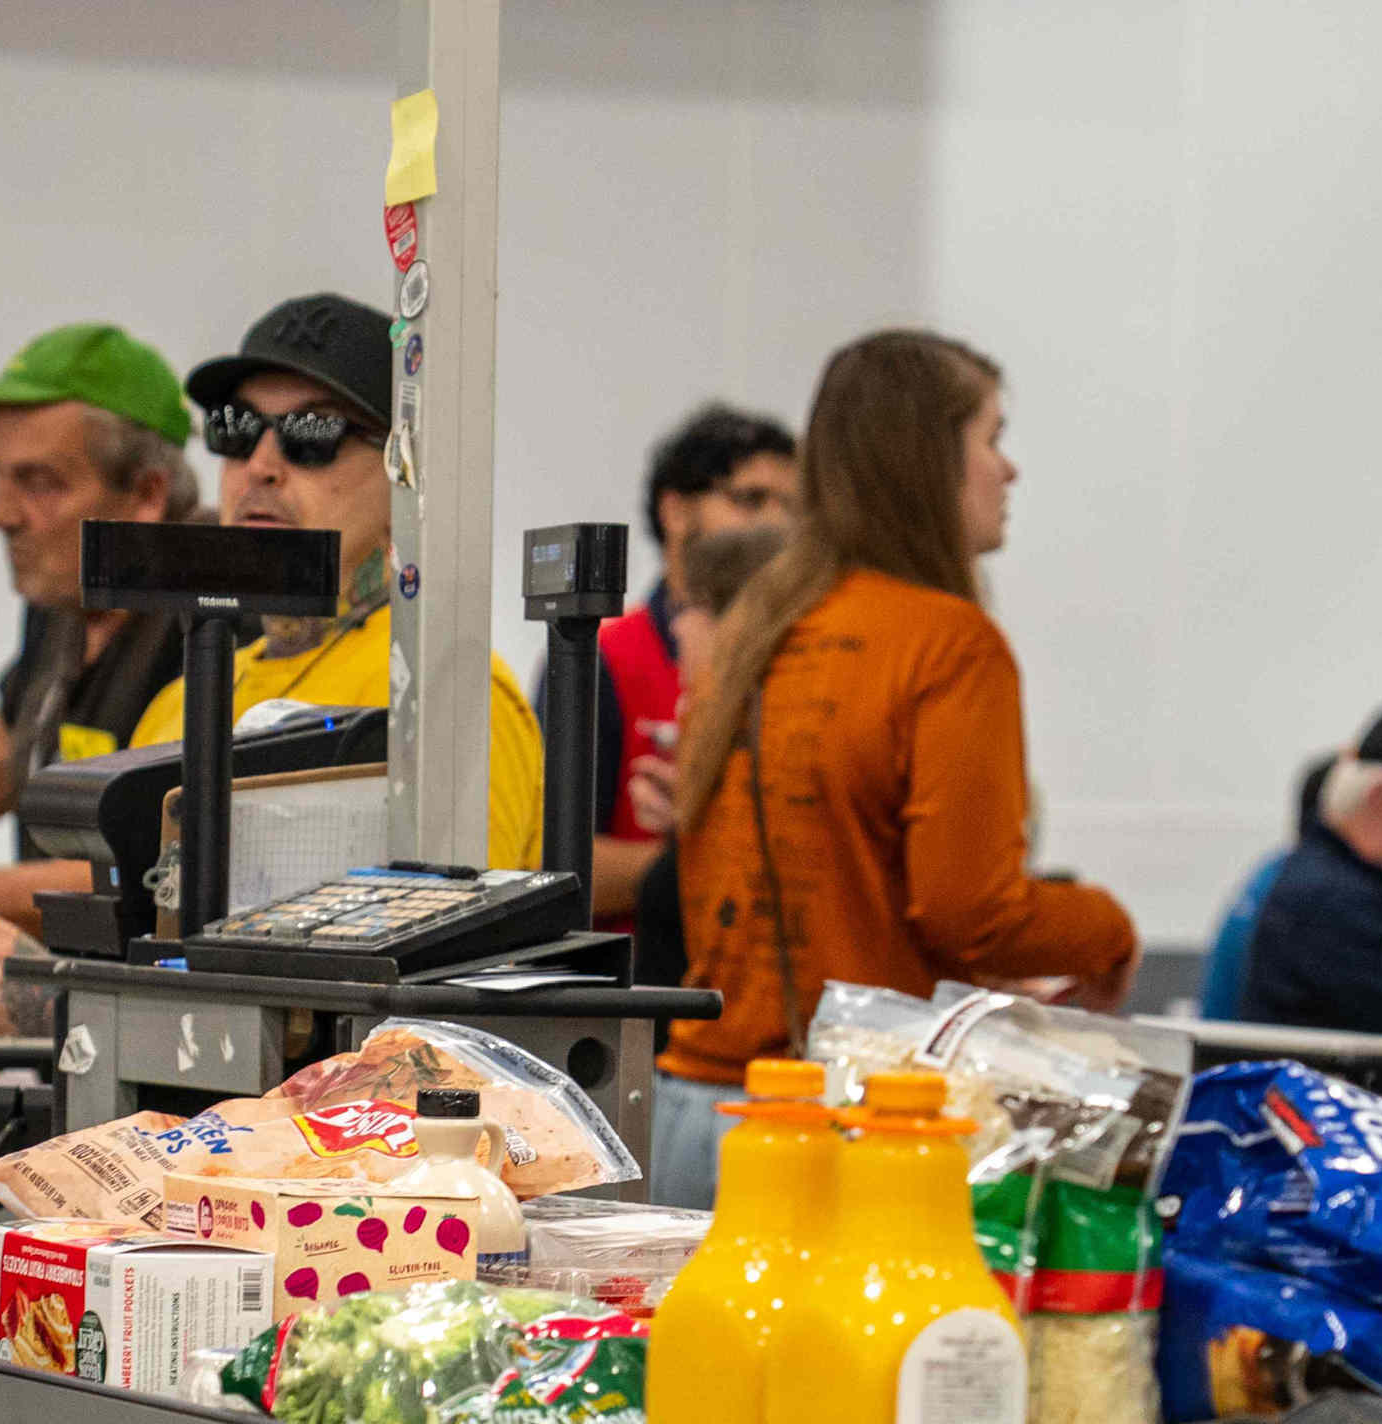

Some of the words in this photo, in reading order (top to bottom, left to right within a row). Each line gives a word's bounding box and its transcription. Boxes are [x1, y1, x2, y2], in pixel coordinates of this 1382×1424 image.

[124, 1267, 135, 1312] POCKETS
[124, 1315, 133, 1341] FRUIT
[170, 1292, 180, 1349] INSTRUCTIONS
[170, 1351, 179, 1386] HEATING
